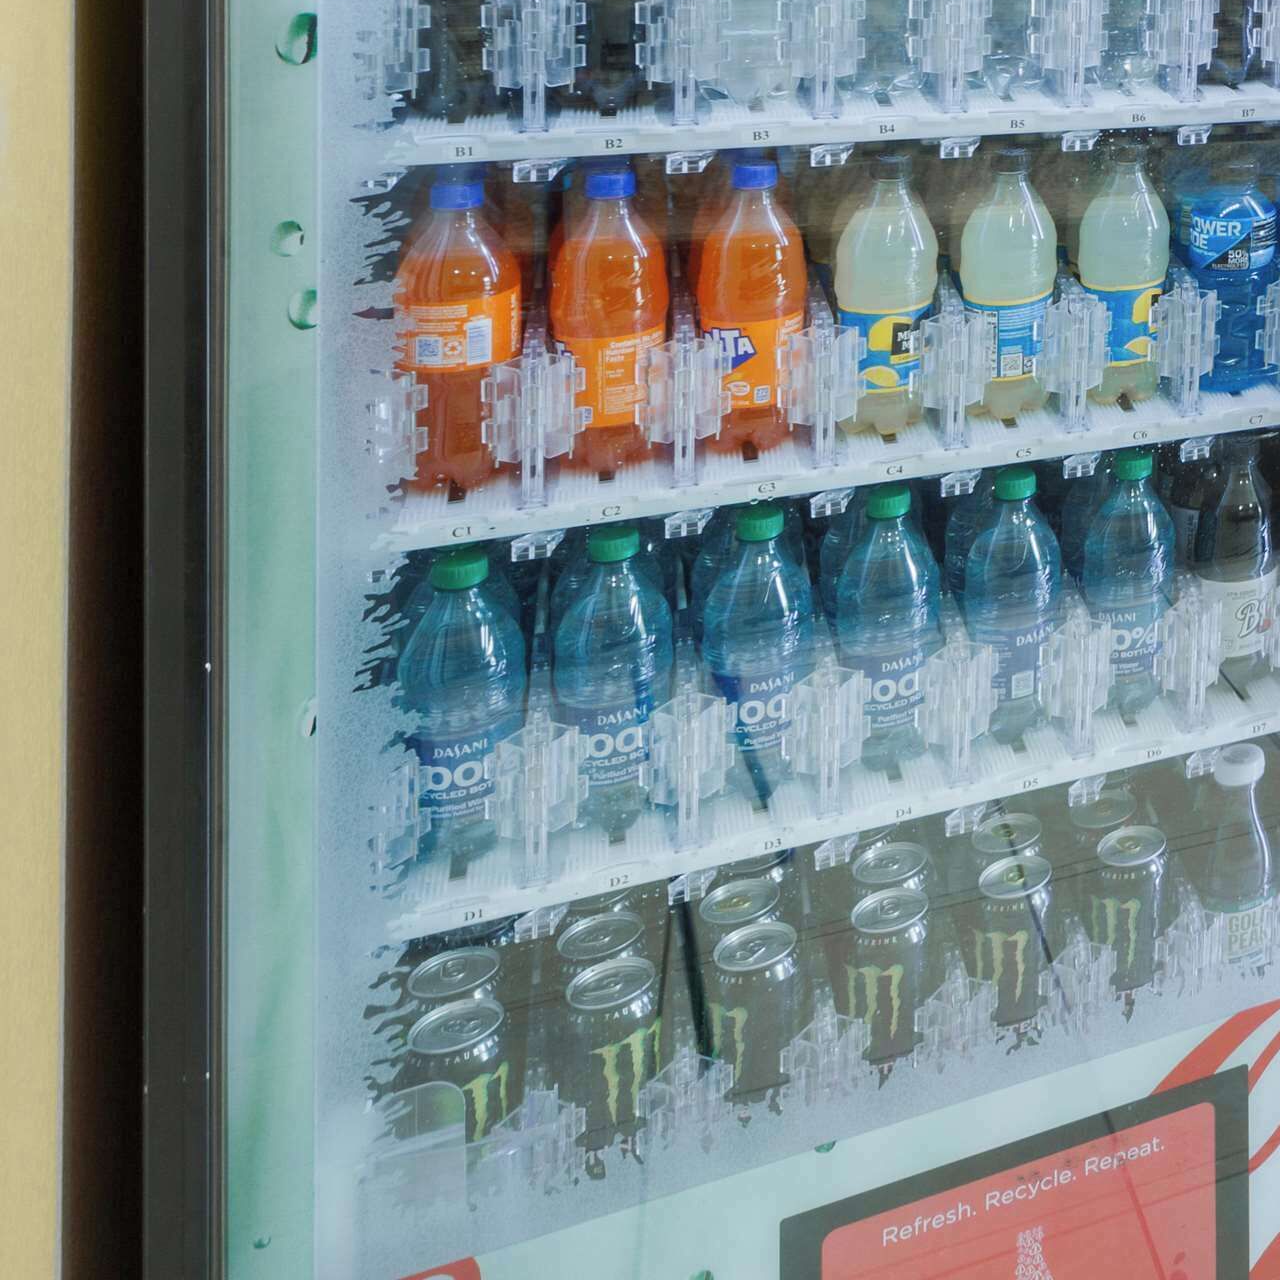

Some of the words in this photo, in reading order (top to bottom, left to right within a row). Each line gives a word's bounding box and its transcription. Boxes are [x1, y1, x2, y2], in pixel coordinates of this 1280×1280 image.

[1132, 113, 1146, 122] B6
[1242, 109, 1255, 117] B7
[879, 125, 895, 134] B4
[1010, 119, 1025, 129] B5
[753, 131, 770, 140] B3
[605, 139, 622, 148] B2
[456, 147, 474, 157] B1
[1250, 415, 1263, 425] C7
[1133, 430, 1147, 440] C6
[1016, 447, 1031, 458] C5
[886, 465, 903, 476] C4
[758, 483, 776, 494] C3
[603, 505, 620, 517] C2
[453, 527, 472, 538] C1
[1252, 722, 1266, 733] D7
[1147, 748, 1162, 759] D6
[1023, 778, 1038, 789] D5
[896, 806, 912, 818] D4
[764, 838, 782, 851] D3
[610, 874, 628, 887] D2
[464, 909, 483, 921] D1
[882, 1200, 978, 1247] Refresh.
[984, 1167, 1078, 1211] Recycle.
[1084, 1135, 1166, 1176] Repeat.
